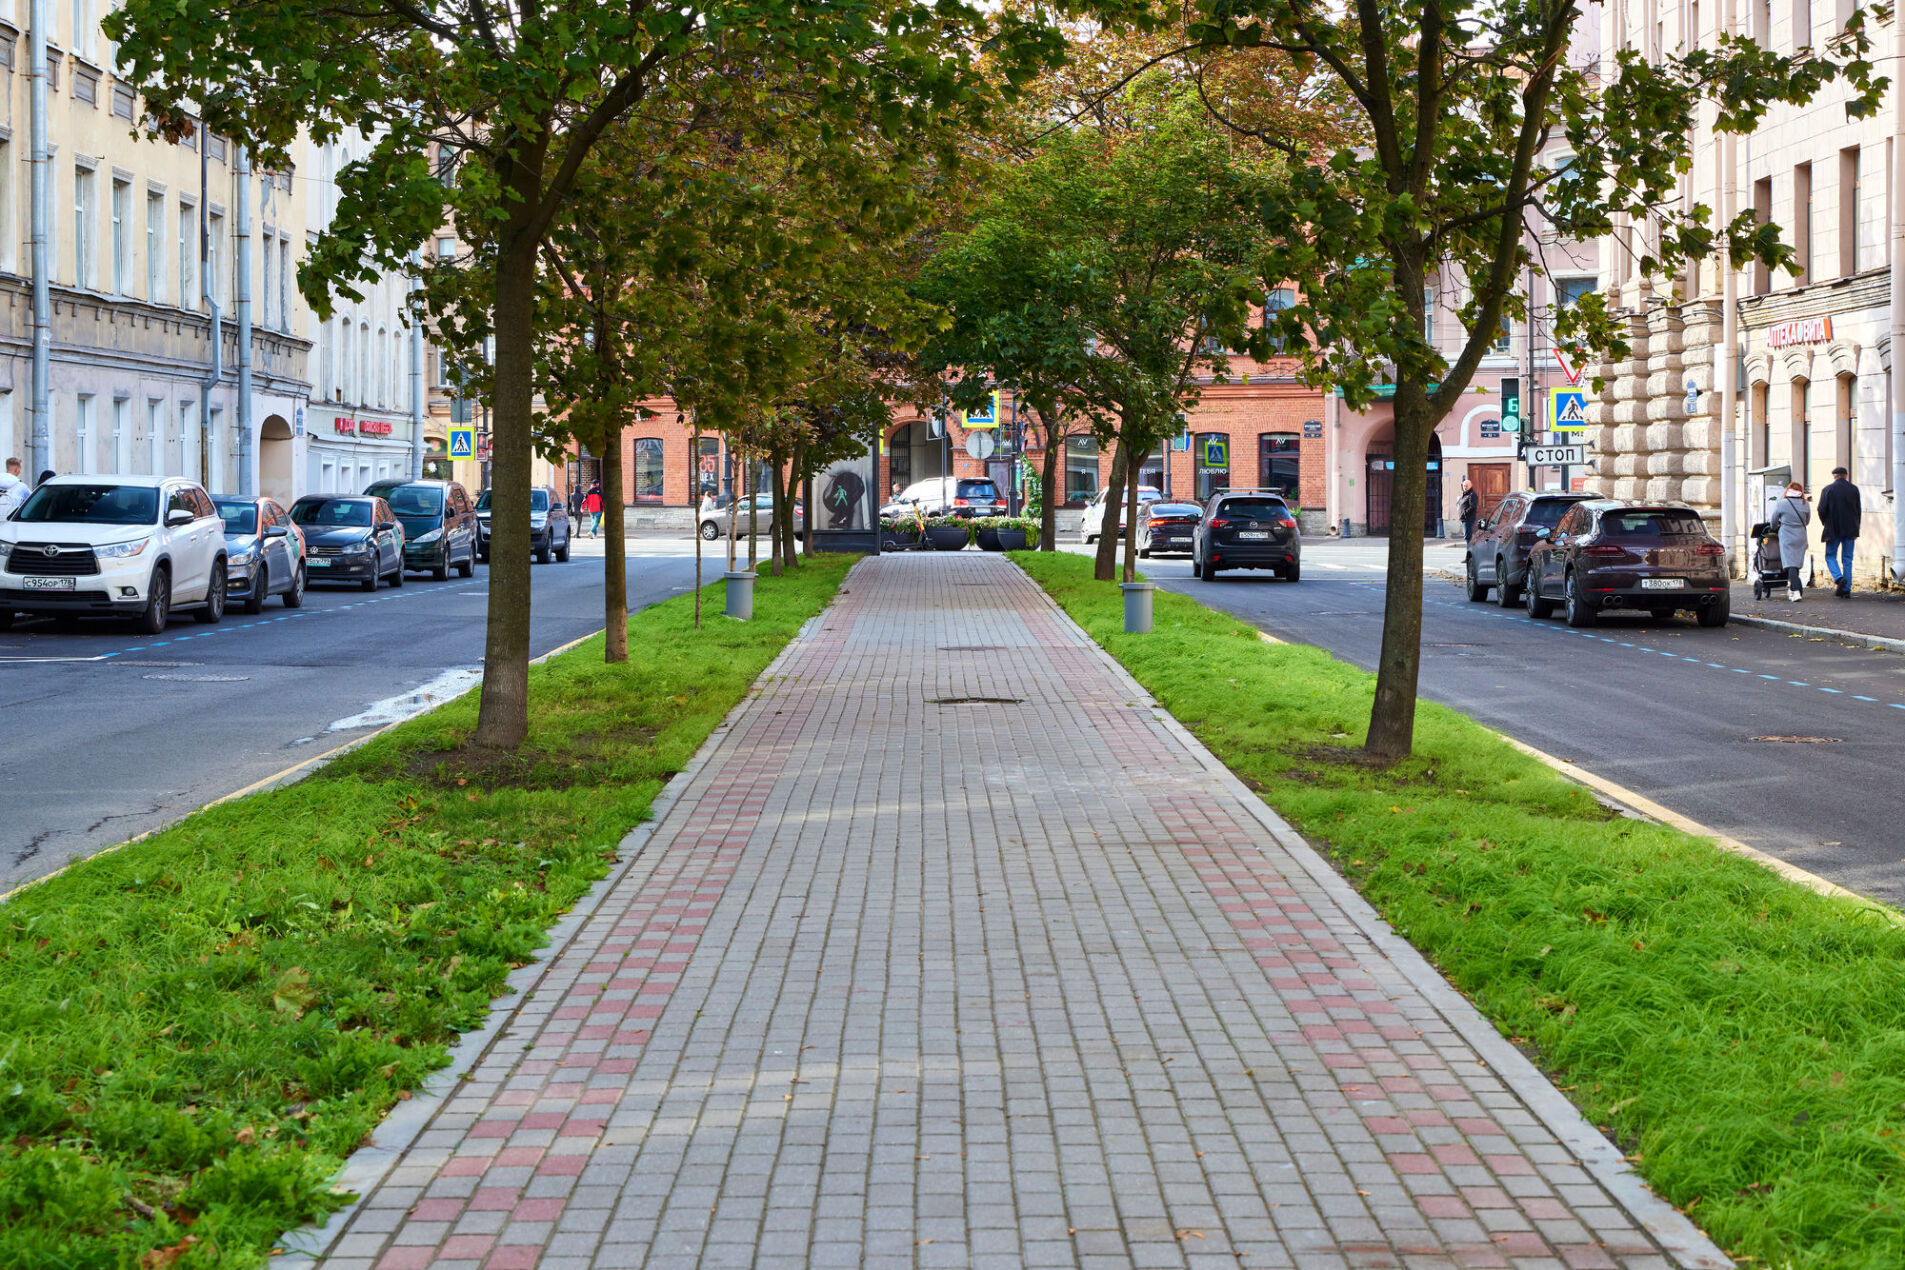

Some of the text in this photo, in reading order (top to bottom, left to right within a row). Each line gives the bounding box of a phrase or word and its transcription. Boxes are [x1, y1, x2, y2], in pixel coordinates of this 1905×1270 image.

[1767, 318, 1827, 347] АПТЕКА ВИТА
[1508, 398, 1519, 412] 6
[1535, 449, 1575, 462] СТОП
